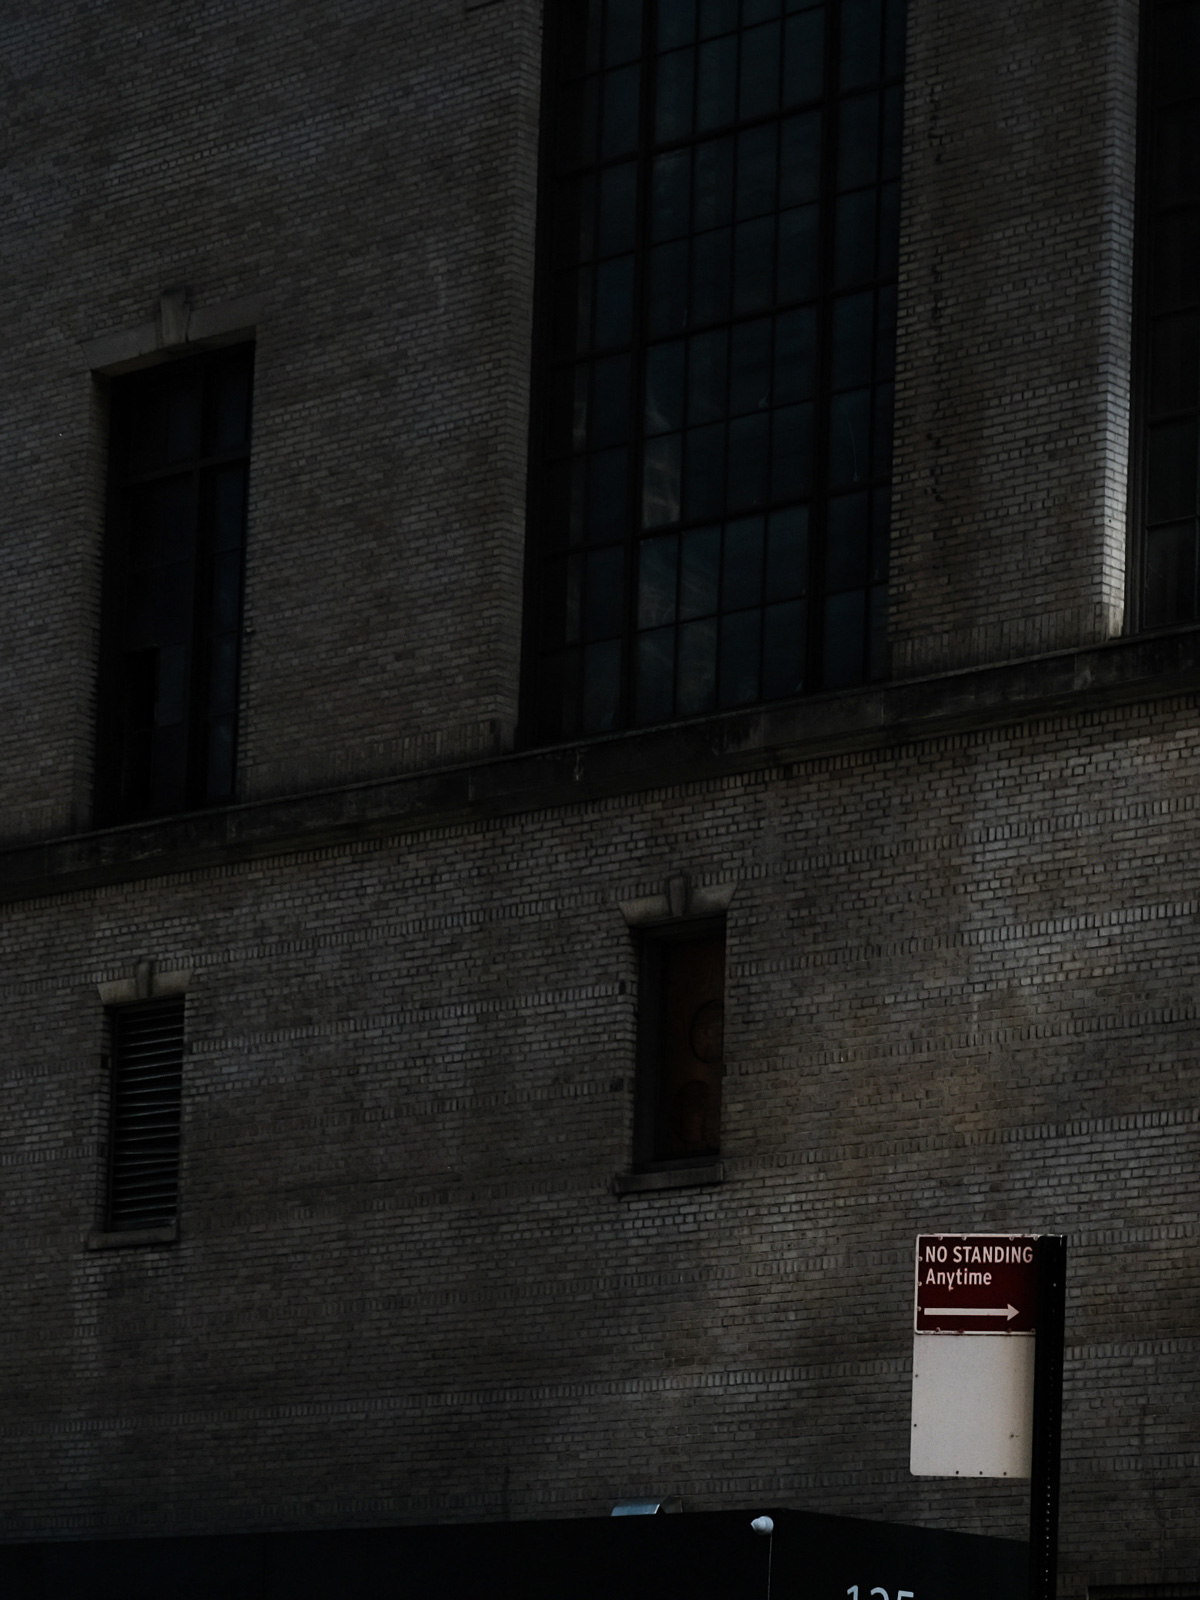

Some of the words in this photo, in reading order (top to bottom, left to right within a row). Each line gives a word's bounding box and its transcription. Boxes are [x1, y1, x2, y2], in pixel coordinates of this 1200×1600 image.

[925, 1245, 949, 1264] NO
[952, 1245, 1034, 1264] STANDING
[925, 1267, 993, 1291] Anytime
